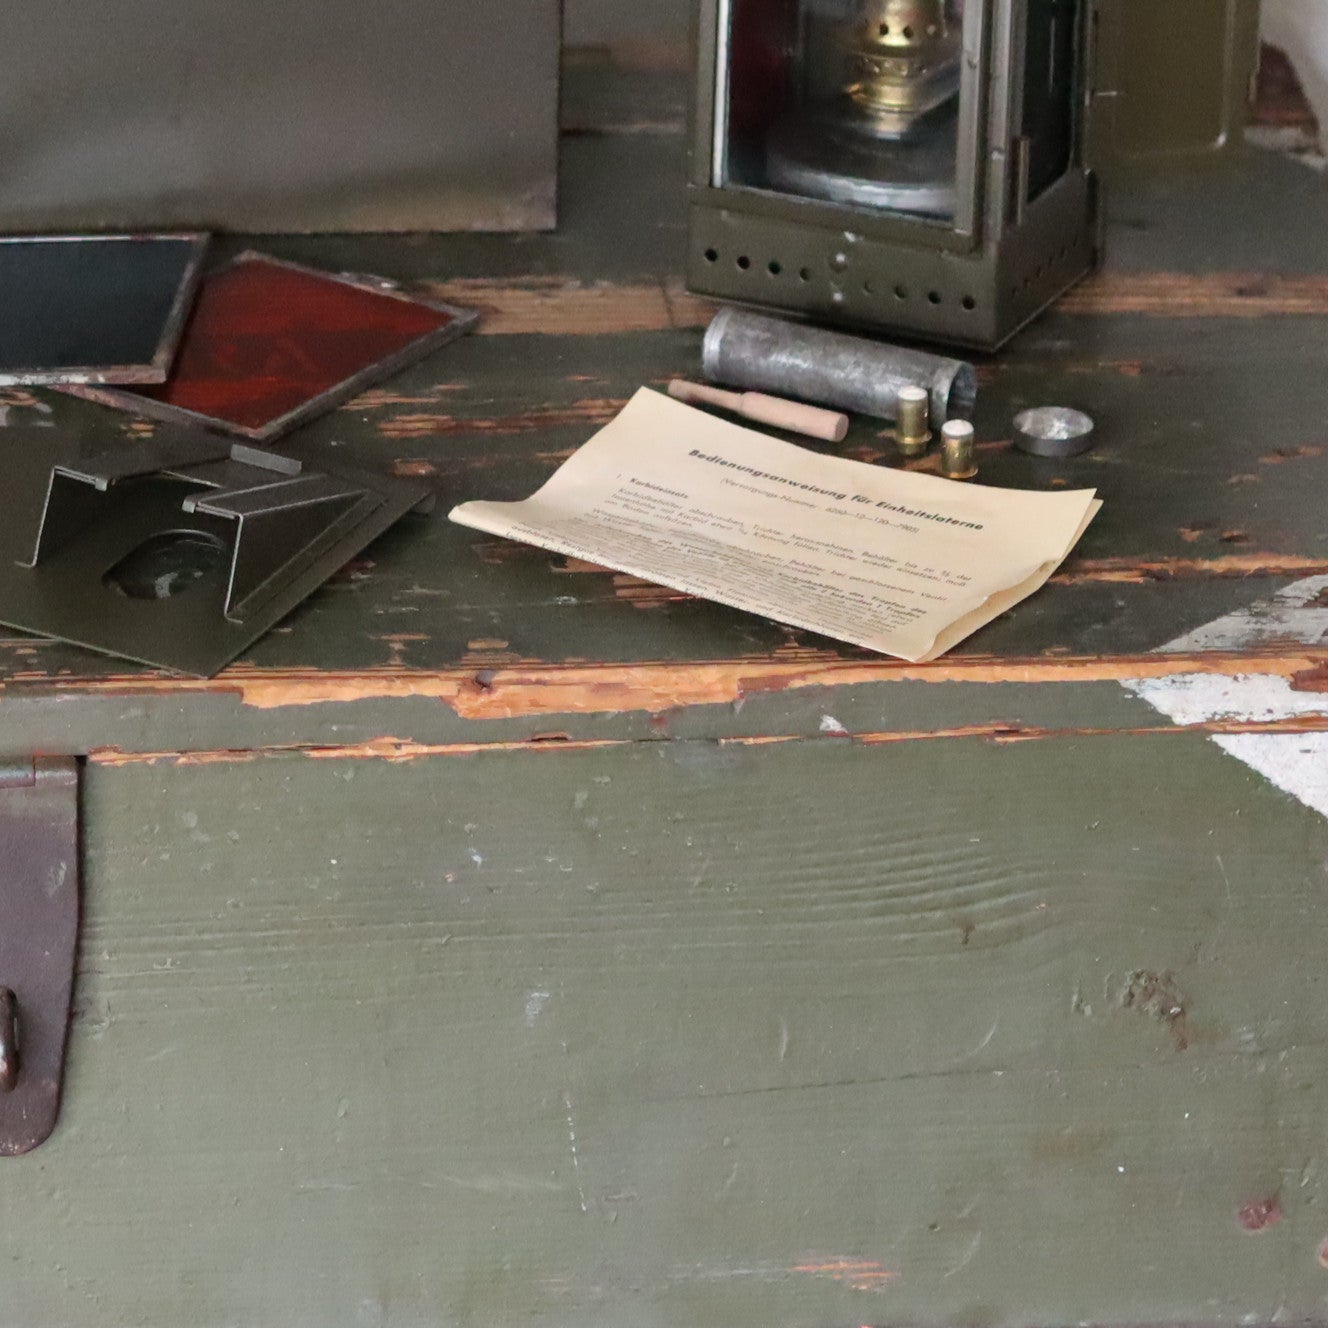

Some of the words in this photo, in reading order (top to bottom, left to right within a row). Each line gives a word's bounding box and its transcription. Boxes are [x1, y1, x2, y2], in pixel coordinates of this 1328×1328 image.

[688, 448, 848, 501] Bedienungsanweisung
[850, 494, 873, 505] für
[875, 501, 984, 530] Einheitslaterne
